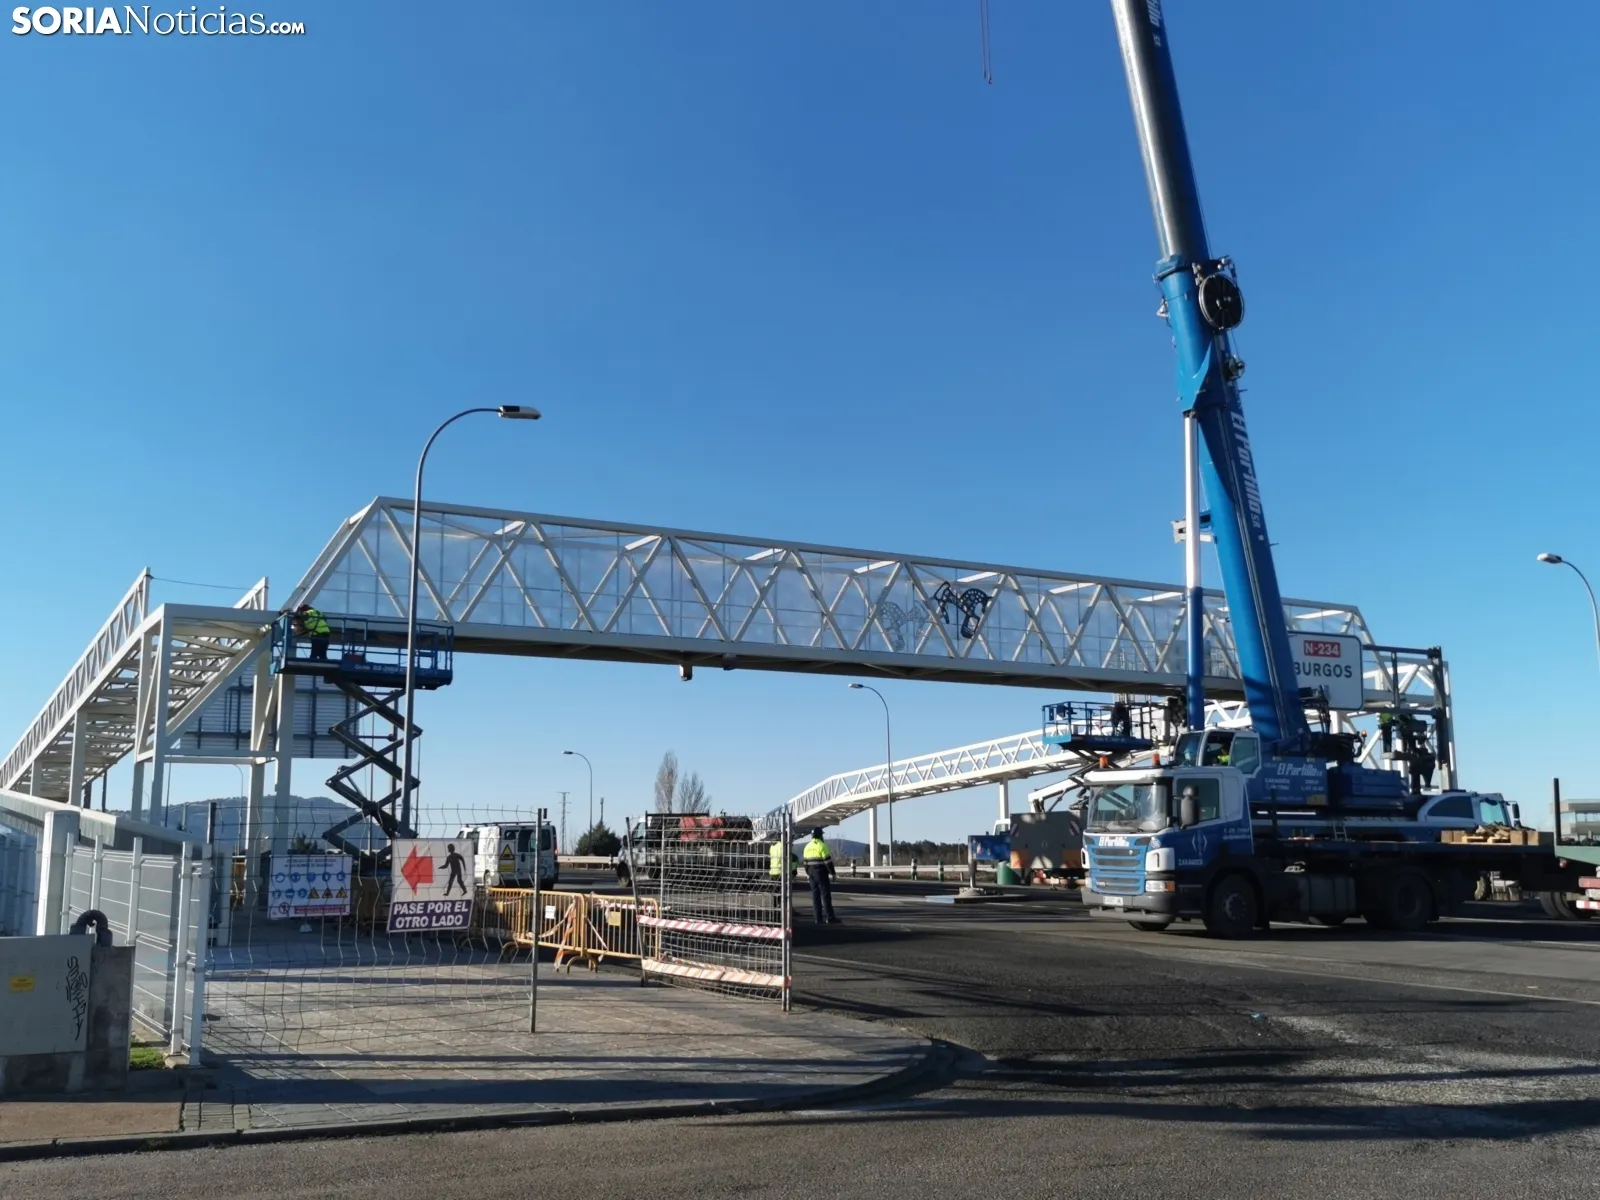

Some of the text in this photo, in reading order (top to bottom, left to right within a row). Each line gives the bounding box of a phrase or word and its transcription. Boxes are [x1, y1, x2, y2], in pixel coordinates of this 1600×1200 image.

[1230, 411, 1247, 433] El
[1234, 432, 1262, 515] Portillo
[1305, 642, 1339, 656] N-234
[1294, 661, 1353, 678] BURGOS
[393, 901, 469, 916] PASE POR EL
[395, 914, 463, 929] OTRO LADO
